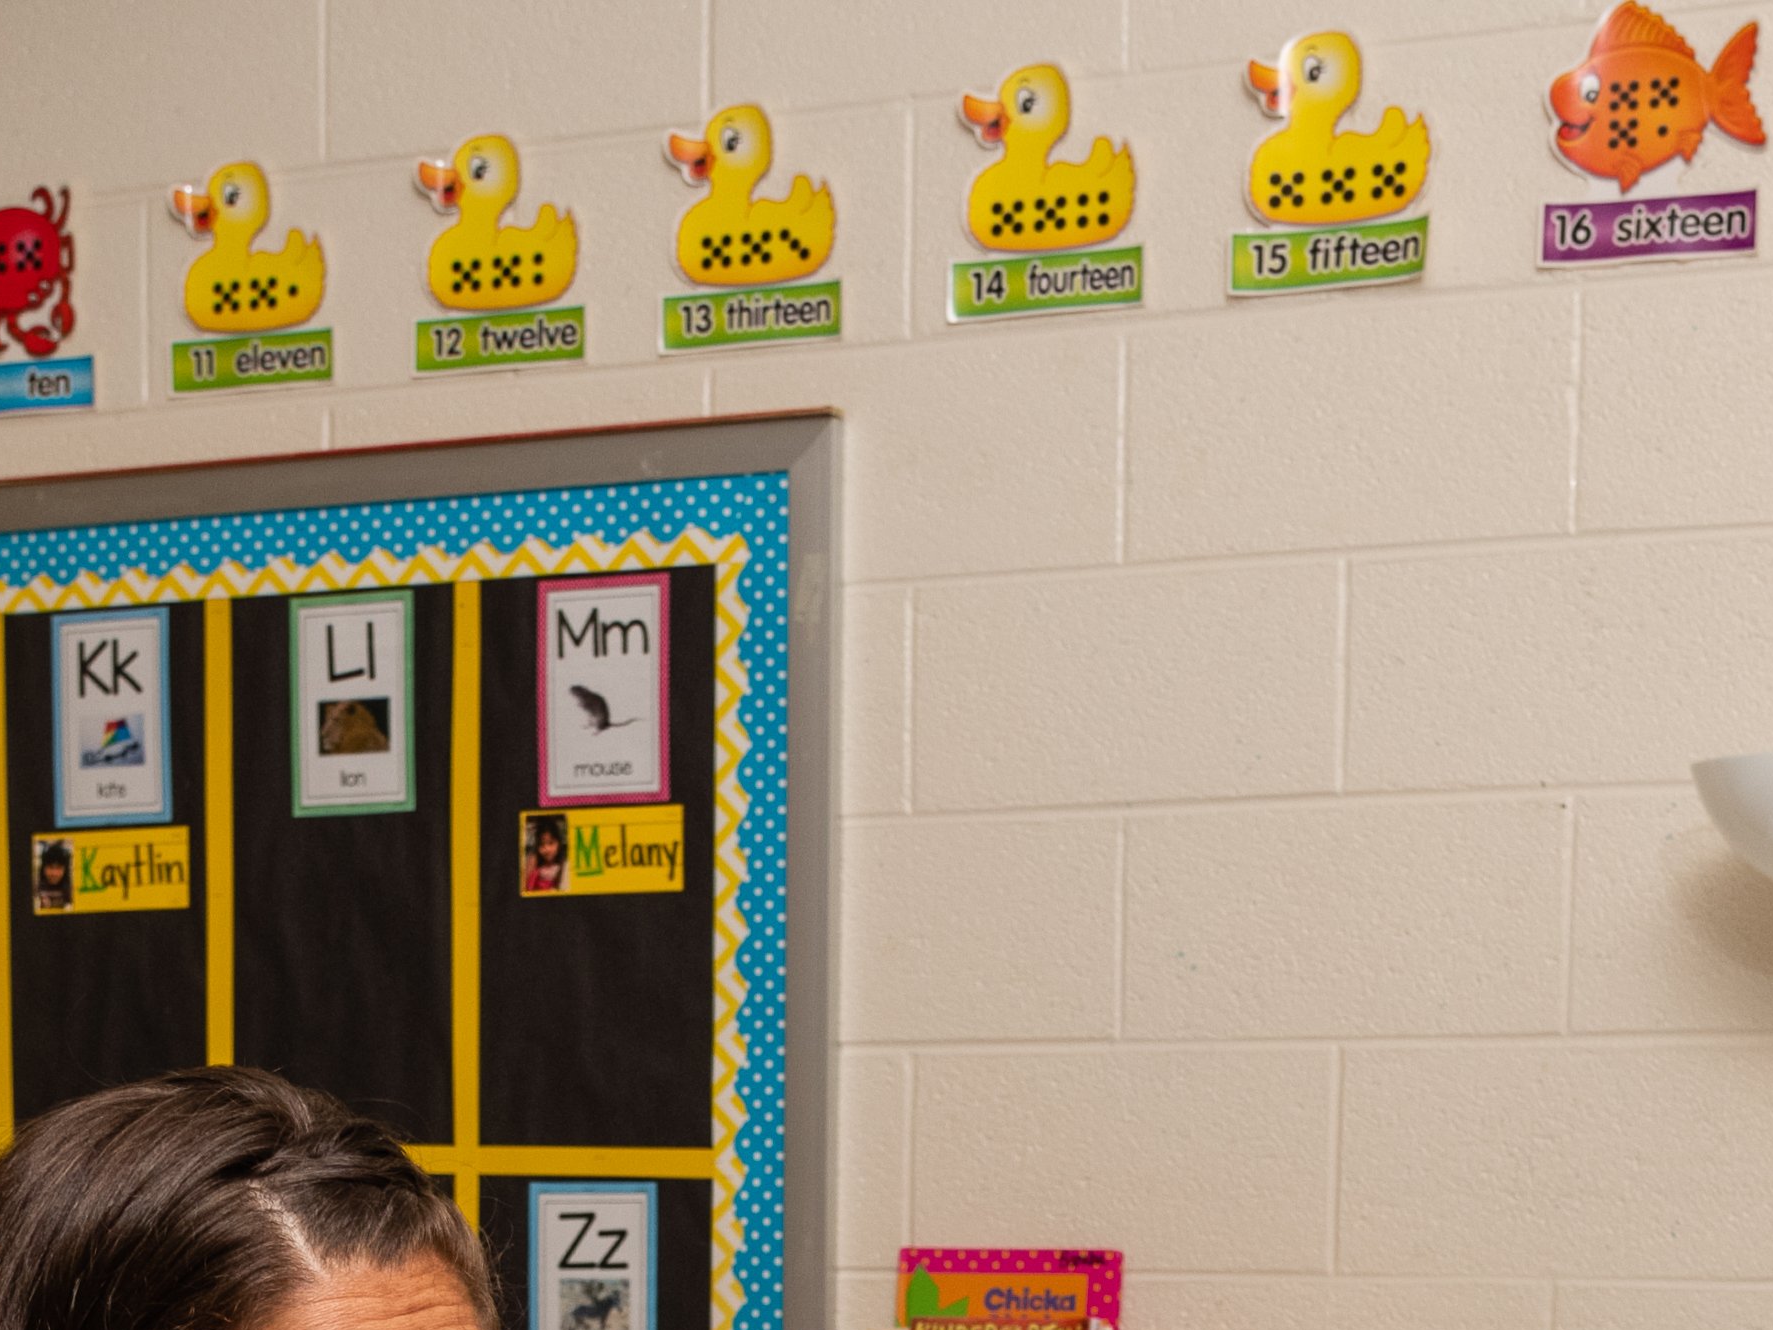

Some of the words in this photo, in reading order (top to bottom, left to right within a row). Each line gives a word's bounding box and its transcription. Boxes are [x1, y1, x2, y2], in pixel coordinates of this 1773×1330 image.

[1553, 213, 1593, 247] 16
[1616, 206, 1748, 243] sixteen
[1253, 238, 1291, 276] 15
[1309, 229, 1421, 272] fifteen
[970, 267, 1005, 303] 14
[1028, 257, 1135, 298] fourteen
[681, 300, 713, 335] 13
[725, 292, 832, 332] thirteen
[193, 347, 215, 377] 11
[235, 341, 326, 373] eleven
[433, 326, 461, 360] 12
[480, 315, 578, 354] twelve
[26, 369, 71, 398] ten
[556, 607, 651, 660] Mm
[78, 639, 144, 699] Kk
[339, 768, 368, 789] lion
[573, 759, 635, 779] mouse
[78, 847, 186, 901] Kaytlin
[574, 824, 682, 881] Melany
[558, 1213, 628, 1270] Zz
[984, 1287, 1076, 1313] Chicka
